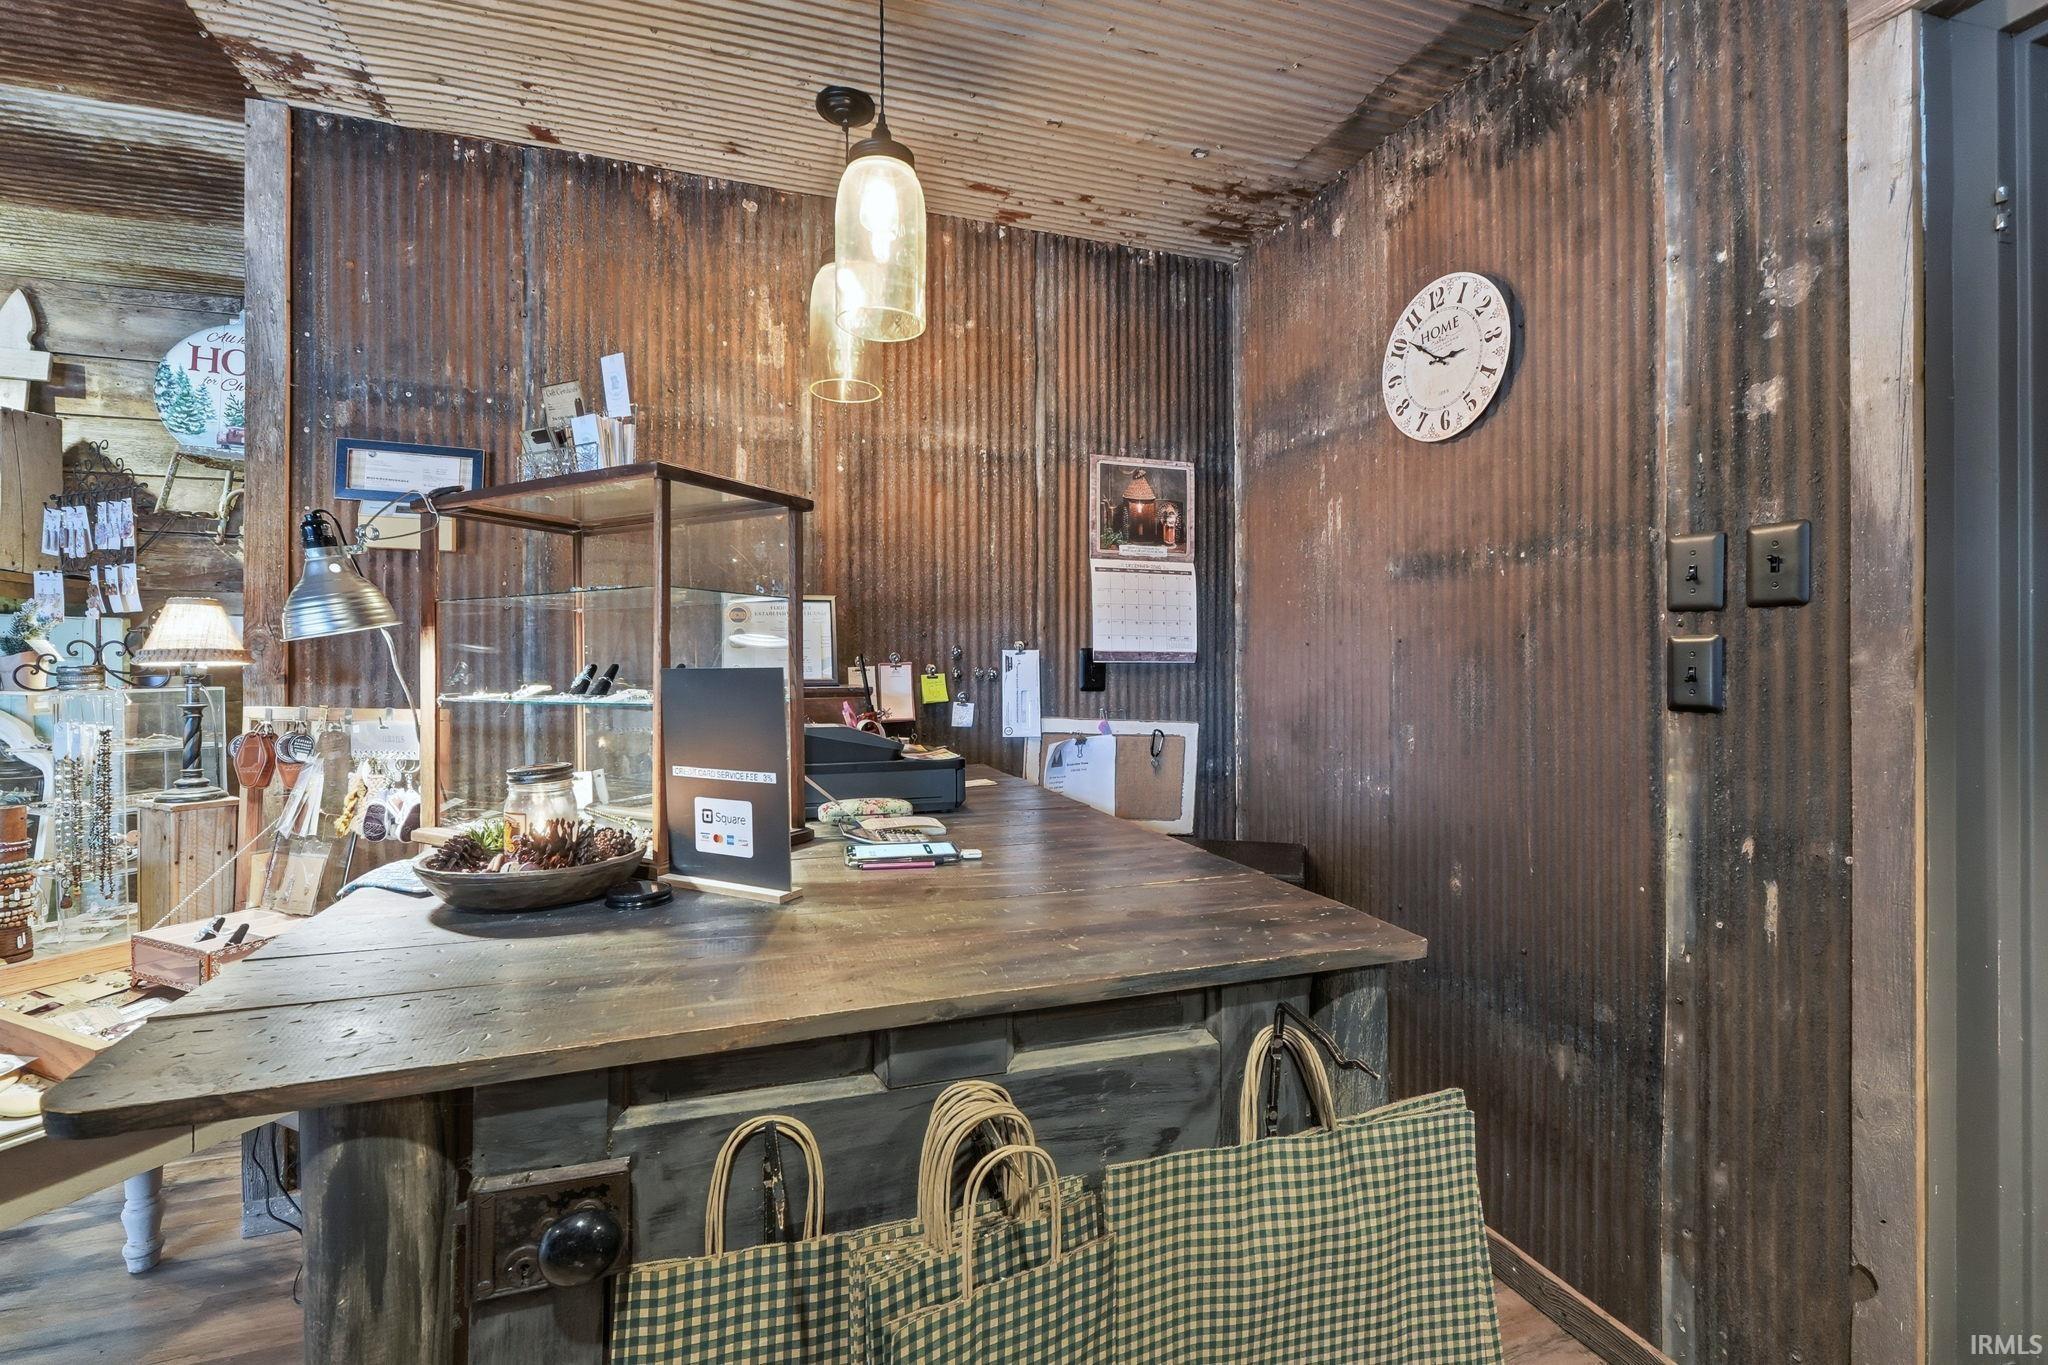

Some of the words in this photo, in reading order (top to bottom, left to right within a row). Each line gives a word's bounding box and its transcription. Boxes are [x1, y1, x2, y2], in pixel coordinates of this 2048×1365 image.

[1429, 286, 1445, 312] 12
[1456, 281, 1468, 304] 1
[1474, 294, 1492, 317] 2
[1405, 309, 1423, 332] 11
[1420, 315, 1460, 344] HOME
[206, 332, 235, 344] All
[1484, 326, 1502, 343] 3
[1390, 338, 1408, 360] 10
[201, 376, 219, 387] for
[1387, 374, 1403, 389] 9
[1480, 364, 1498, 379] 4
[1395, 398, 1410, 417] 8
[1462, 391, 1477, 412] 5
[1415, 411, 1429, 432] 7
[1440, 409, 1451, 431] 6
[674, 767, 697, 776] CREDIT
[698, 769, 716, 777] CARD
[716, 770, 744, 780] SERVICE
[745, 772, 758, 782] FEE
[763, 774, 773, 783] 3%
[715, 812, 747, 826] Square
